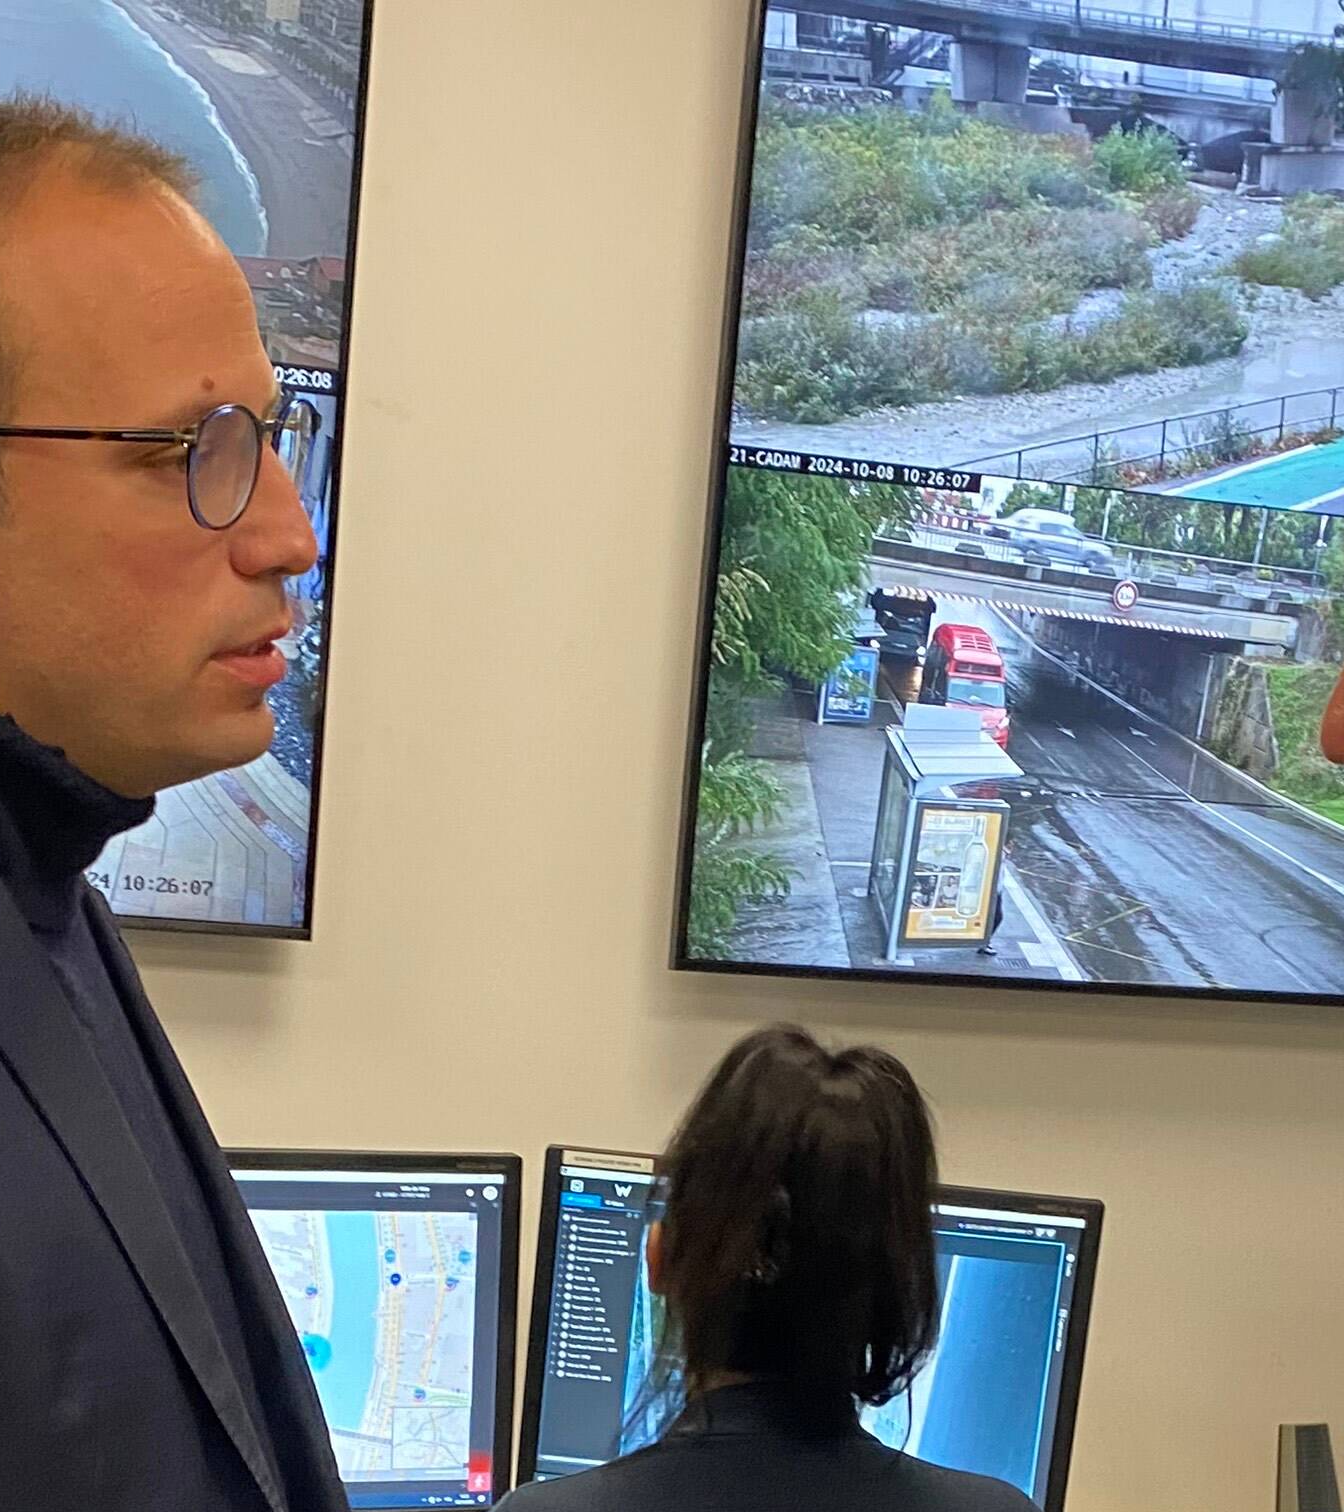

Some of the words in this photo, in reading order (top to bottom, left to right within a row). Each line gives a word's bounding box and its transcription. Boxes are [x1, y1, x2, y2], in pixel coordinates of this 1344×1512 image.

[273, 366, 333, 389] 0:26:08
[807, 456, 895, 481] 2024-10-08
[903, 468, 971, 488] 10:26:07
[122, 874, 214, 897] 10:26:07
